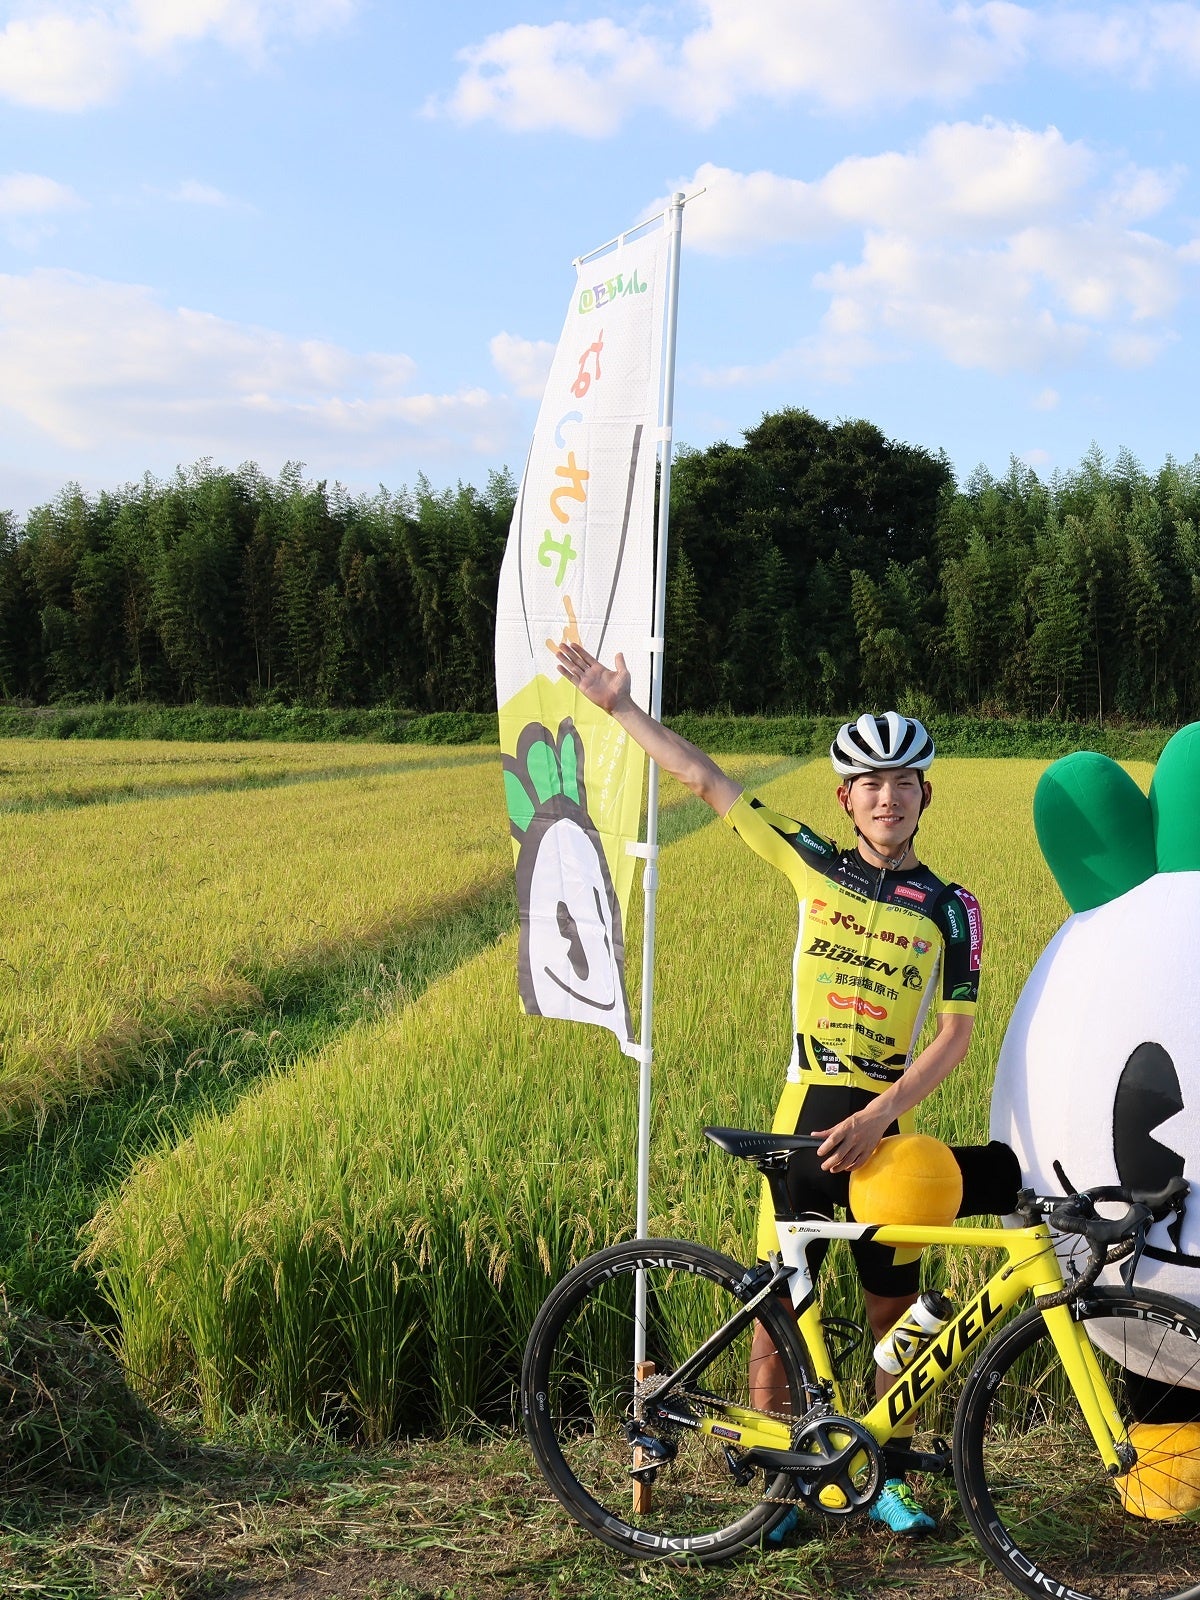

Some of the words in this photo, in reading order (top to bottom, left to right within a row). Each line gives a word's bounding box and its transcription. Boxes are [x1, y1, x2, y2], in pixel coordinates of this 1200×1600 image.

[800, 832, 827, 855] Grandy
[830, 911, 910, 949] パリッと朝食
[947, 905, 959, 938] Grandy
[967, 907, 979, 950] kanseki
[833, 944, 858, 954] NASU
[835, 972, 899, 1000] 那須塩原市
[864, 1071, 887, 1079] wahoo
[1043, 1201, 1055, 1212] 3T
[586, 1257, 724, 1288] GOKISO
[888, 1291, 1003, 1428] DEVEL
[604, 1516, 745, 1550] GOKISO
